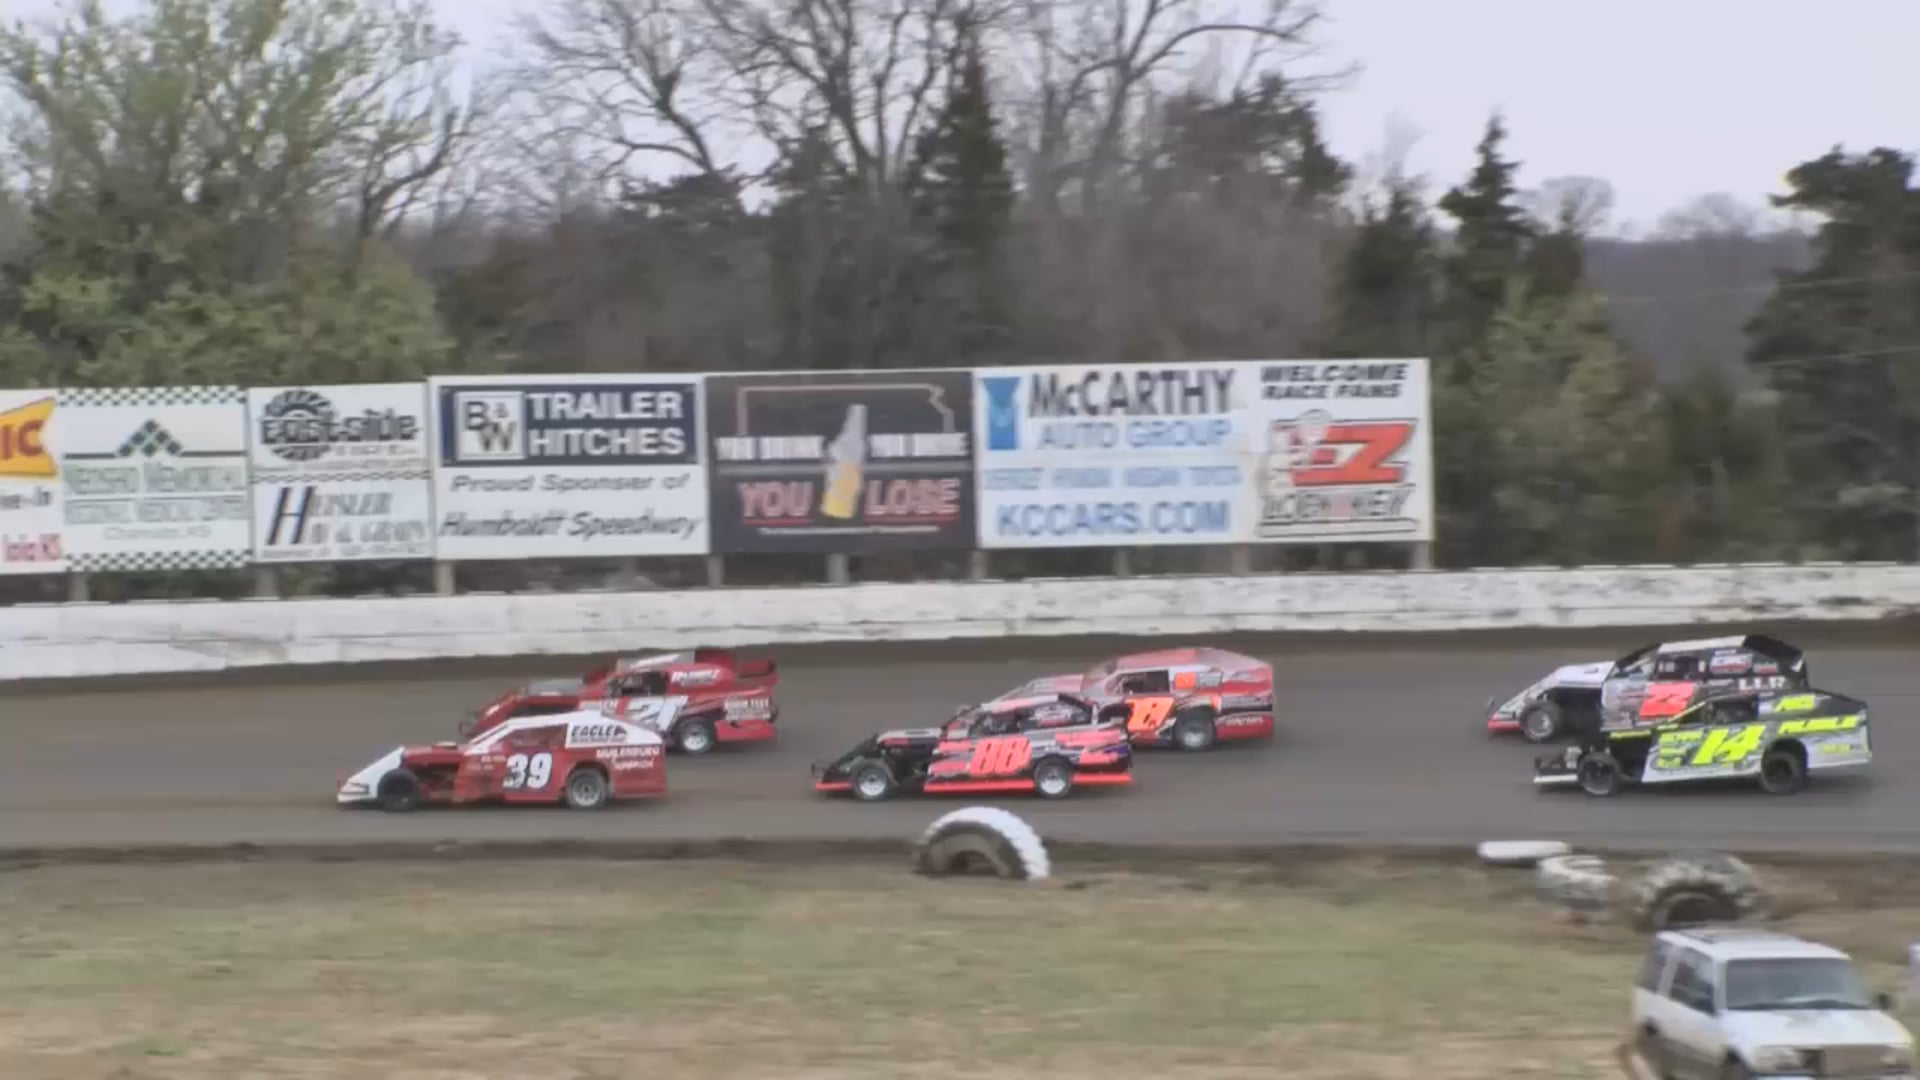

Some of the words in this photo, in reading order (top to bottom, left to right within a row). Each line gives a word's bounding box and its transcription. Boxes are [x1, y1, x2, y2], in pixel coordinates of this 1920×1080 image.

[1260, 364, 1408, 382] WELCOME
[529, 391, 683, 420] TRAILER
[1028, 369, 1236, 418] McCARTHY
[1261, 385, 1328, 399] RACE
[528, 427, 686, 456] HITCHES
[451, 475, 535, 491] Proud
[740, 481, 814, 518] YOU
[865, 478, 960, 516] LOSE
[1692, 724, 1766, 765] 14
[503, 754, 552, 789] 39
